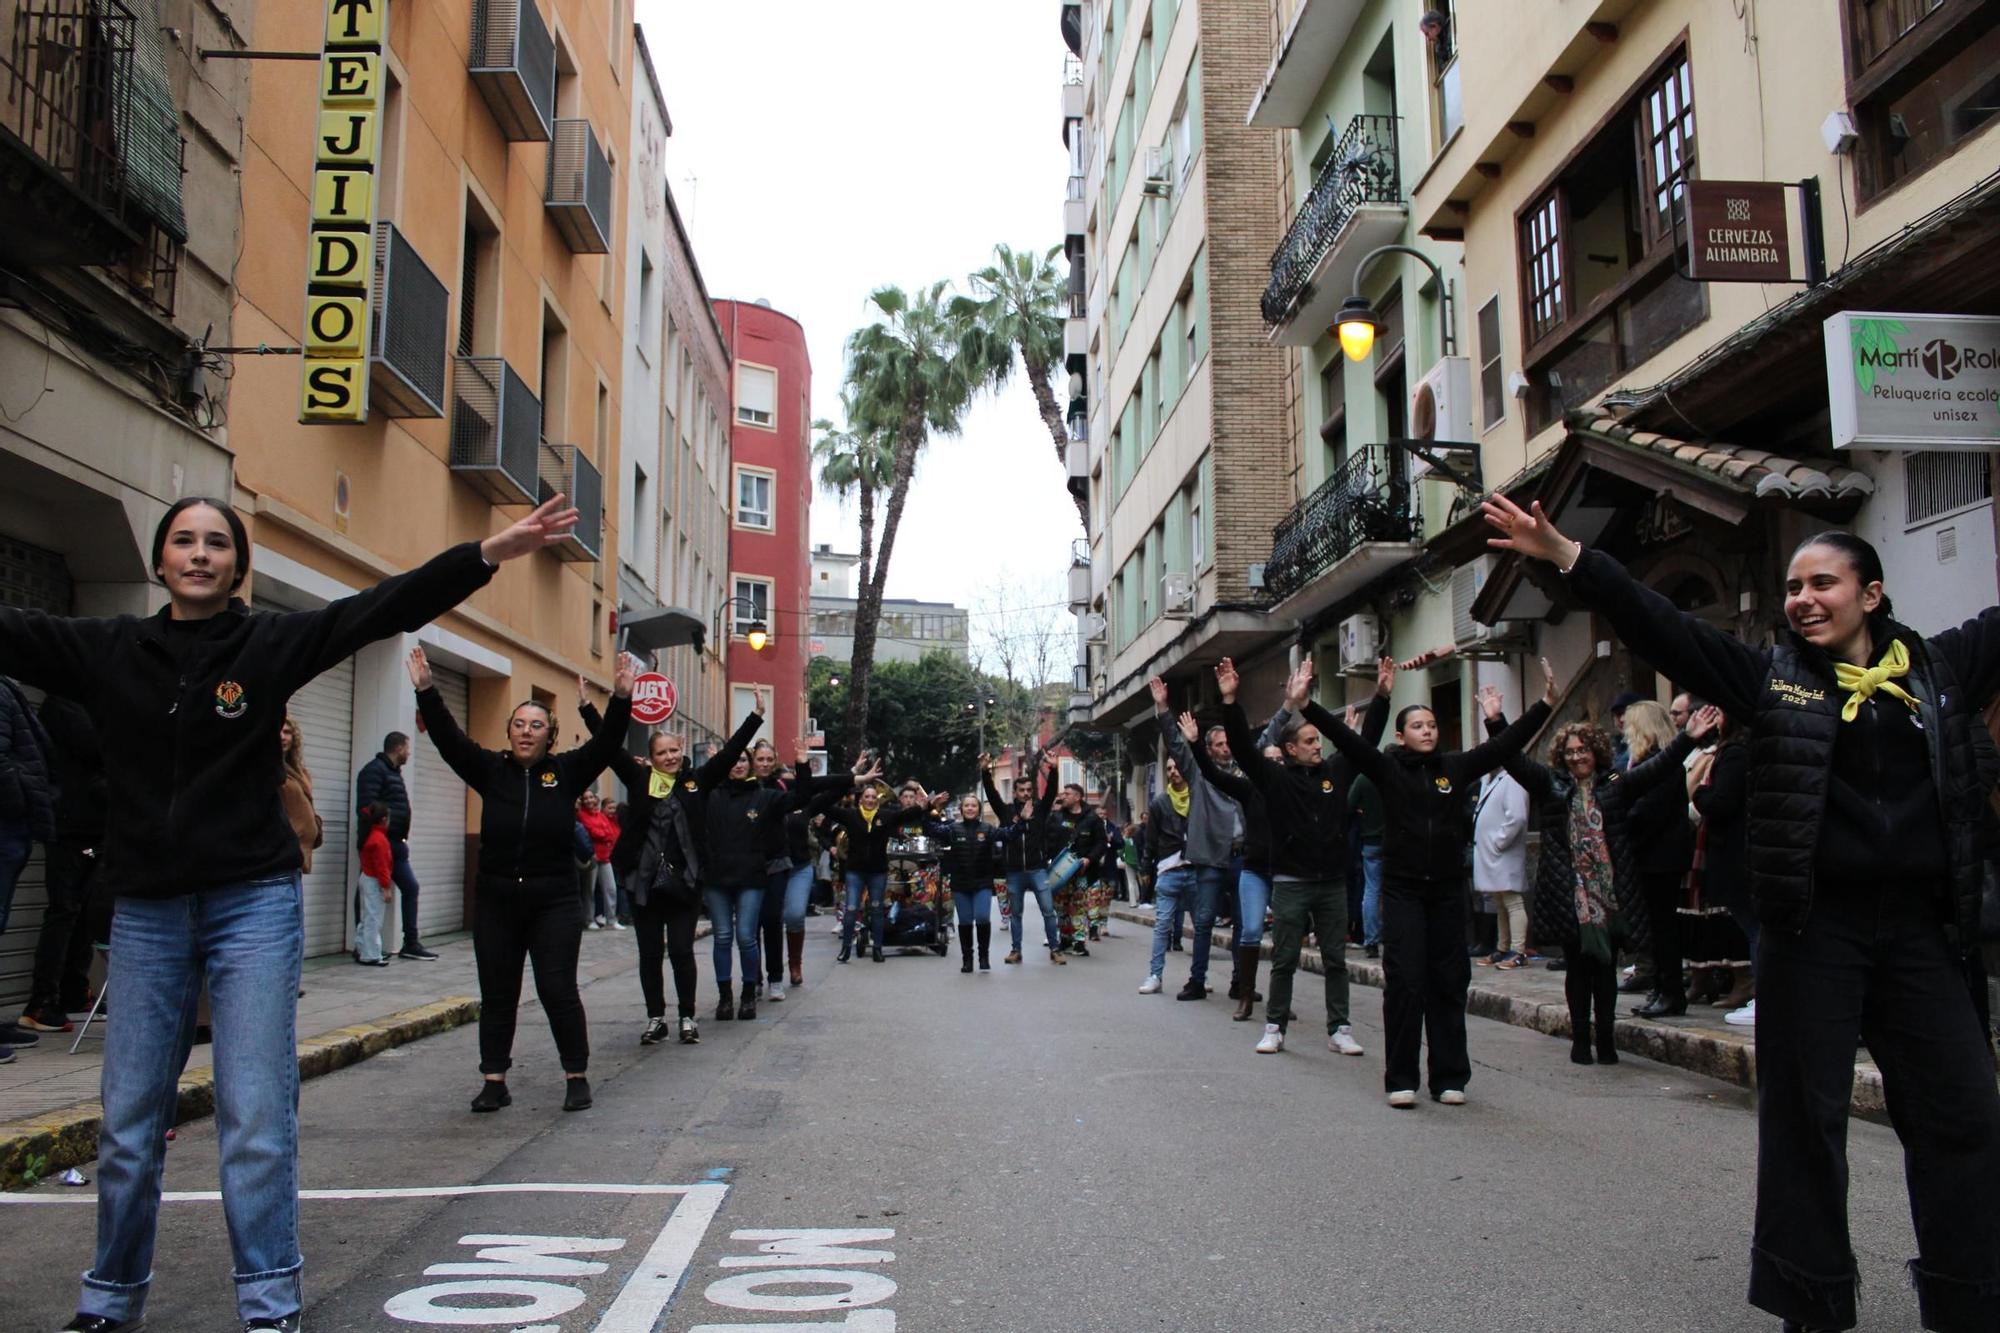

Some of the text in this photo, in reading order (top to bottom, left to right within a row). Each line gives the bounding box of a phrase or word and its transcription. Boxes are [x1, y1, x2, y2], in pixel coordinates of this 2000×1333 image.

[307, 0, 373, 408] TEJIDOS
[1708, 228, 1774, 245] CERVEZAS
[1706, 247, 1779, 263] ALHAMBRA
[1860, 347, 1918, 368] Martí
[1964, 347, 2000, 369] Rol
[1933, 409, 1978, 422] unisex
[632, 681, 669, 700] UGT
